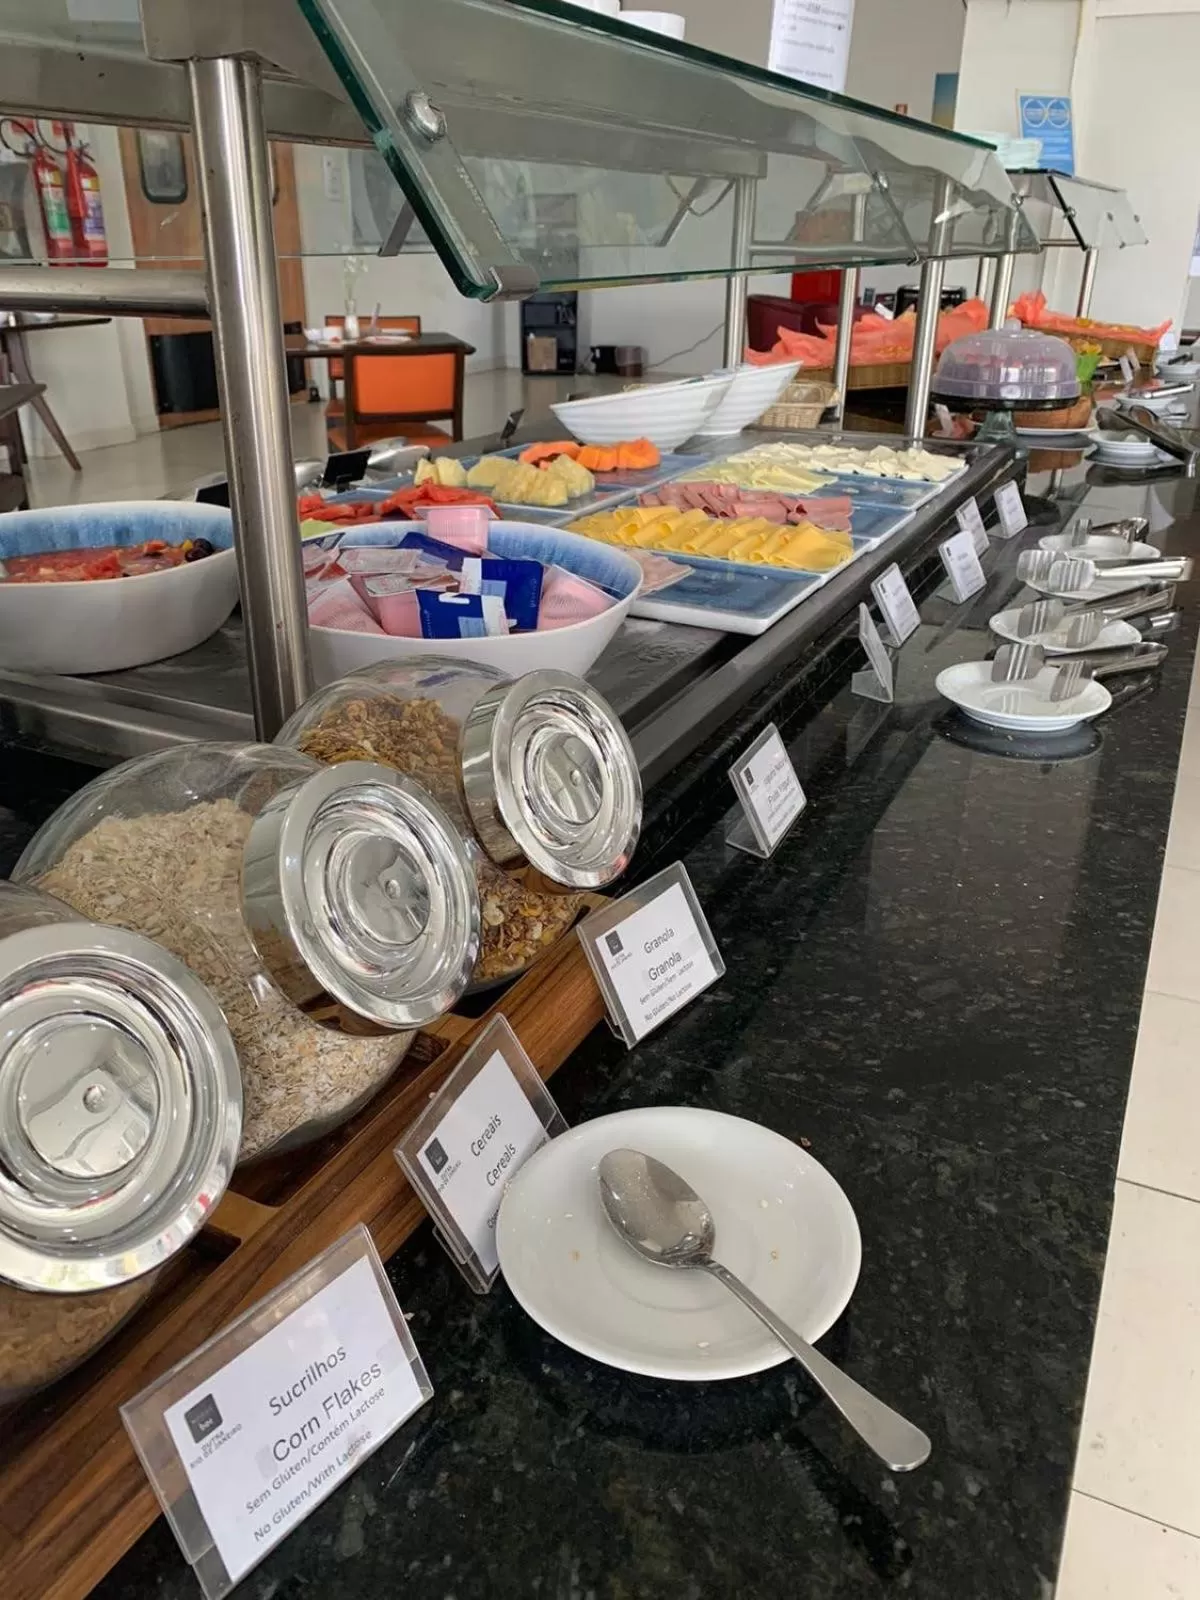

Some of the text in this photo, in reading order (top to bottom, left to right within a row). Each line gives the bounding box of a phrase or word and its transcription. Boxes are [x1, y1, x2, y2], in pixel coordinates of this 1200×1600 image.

[643, 928, 674, 953] Granola
[648, 952, 681, 980] Granola
[470, 1114, 501, 1156] Cereais
[486, 1143, 515, 1186] Cereals
[269, 1347, 345, 1415] Sucrilhos
[273, 1416, 320, 1460] Corn
[322, 1363, 380, 1418] Flakes
[246, 1489, 270, 1513] Sem
[349, 1387, 384, 1421] Lactose
[253, 1523, 271, 1541] No
[335, 1431, 370, 1465] Lactose
